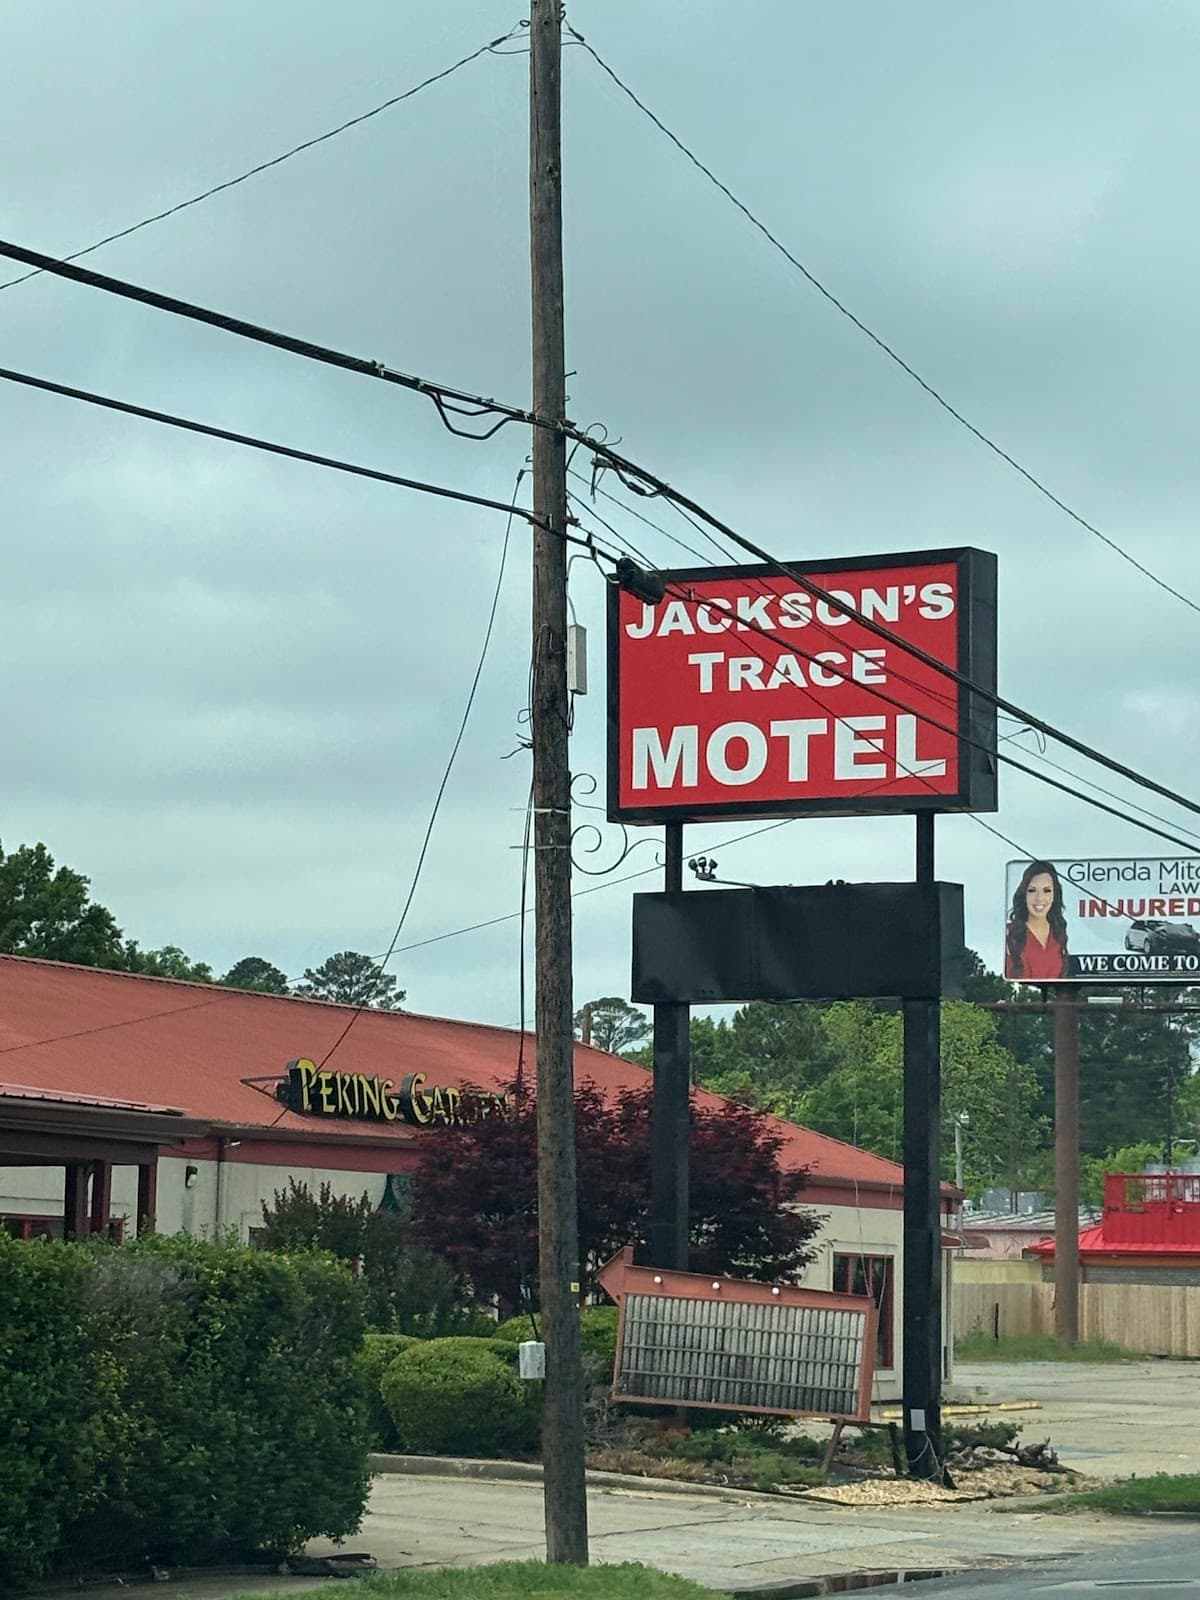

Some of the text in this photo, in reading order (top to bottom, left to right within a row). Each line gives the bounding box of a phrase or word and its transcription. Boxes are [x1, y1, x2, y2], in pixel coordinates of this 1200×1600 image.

[688, 649, 887, 693] TRACE
[631, 714, 946, 790] MOTEL
[1067, 862, 1151, 882] Glenda
[1159, 882, 1200, 894] LAW
[1079, 898, 1200, 917] INJURED
[1078, 955, 1198, 971] WE COME TO
[297, 1058, 400, 1120] PEKING
